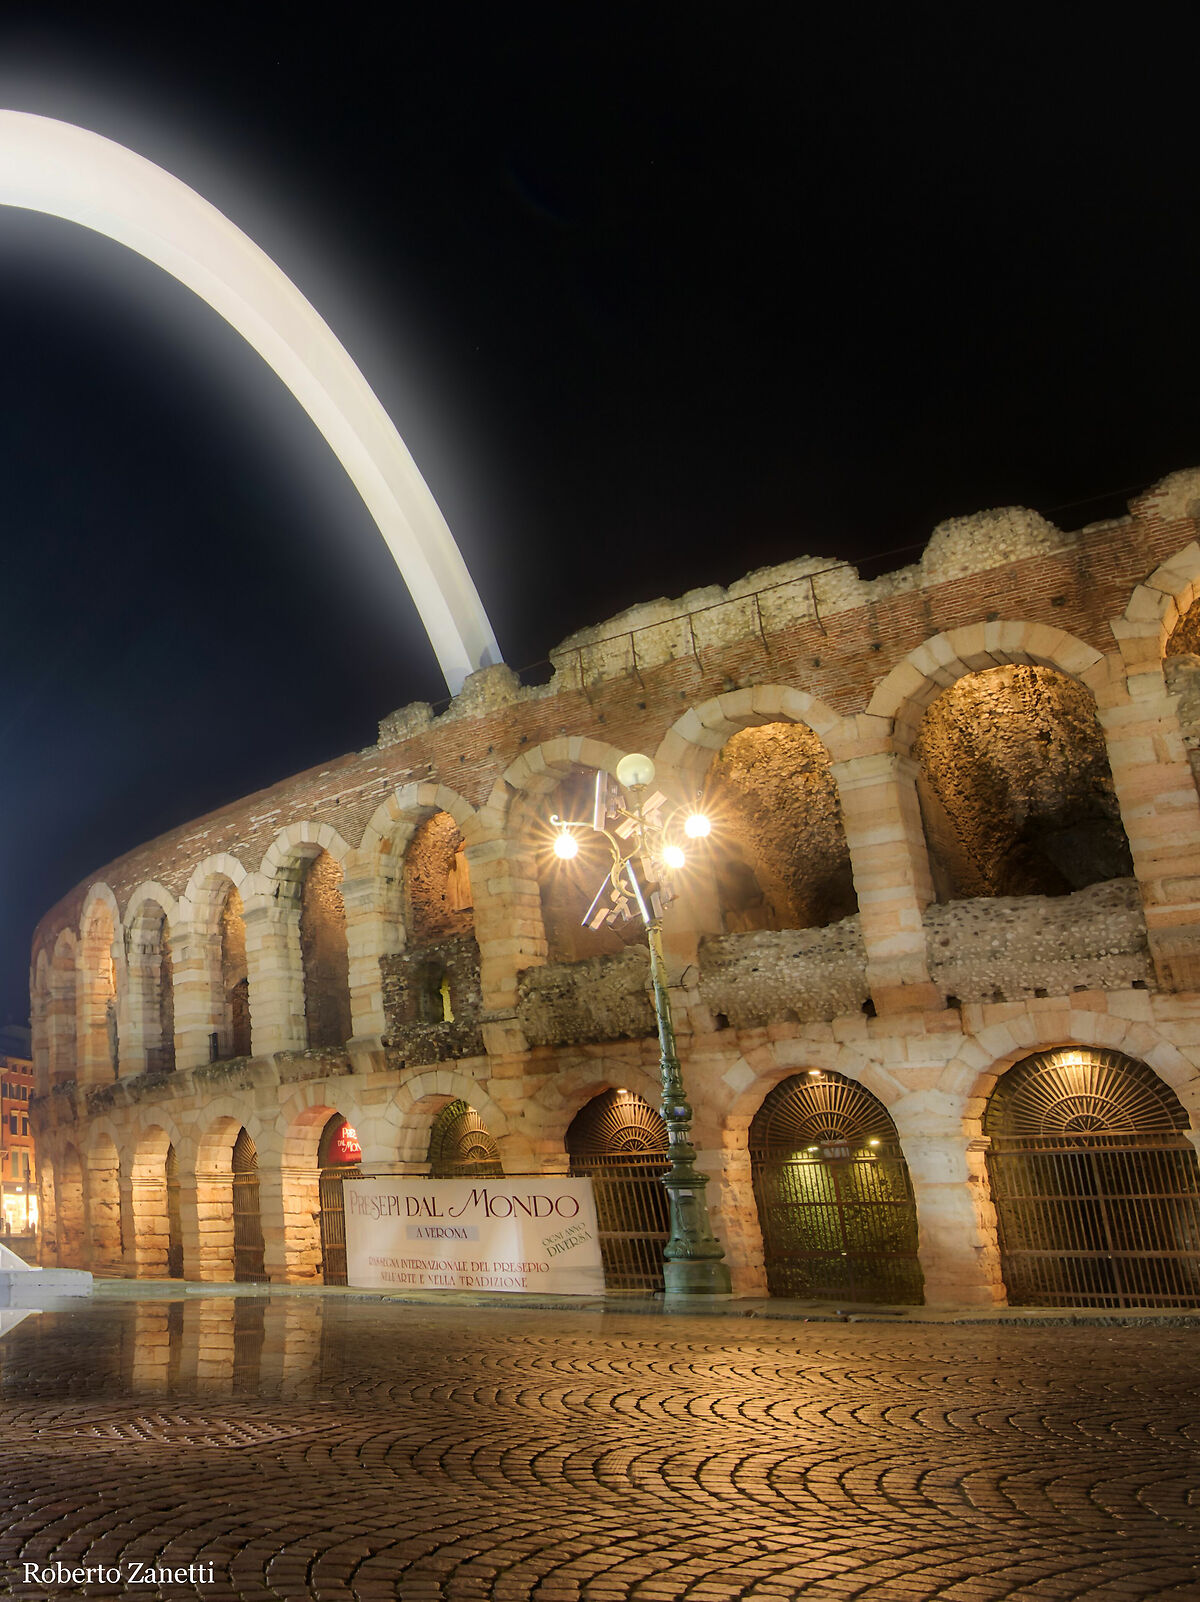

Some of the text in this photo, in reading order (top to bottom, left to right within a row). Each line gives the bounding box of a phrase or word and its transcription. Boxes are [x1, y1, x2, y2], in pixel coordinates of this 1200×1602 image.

[349, 1188, 580, 1220] PRESEPI DAL MONDO
[416, 1227, 468, 1239] A VERONA
[547, 1231, 592, 1257] DIVERSA
[401, 1259, 468, 1272] INTERNAZIONALE
[471, 1262, 490, 1272] DEL
[493, 1263, 550, 1273] PRESEPIO
[420, 1274, 425, 1284] E
[459, 1276, 528, 1288] TRADIZIONE
